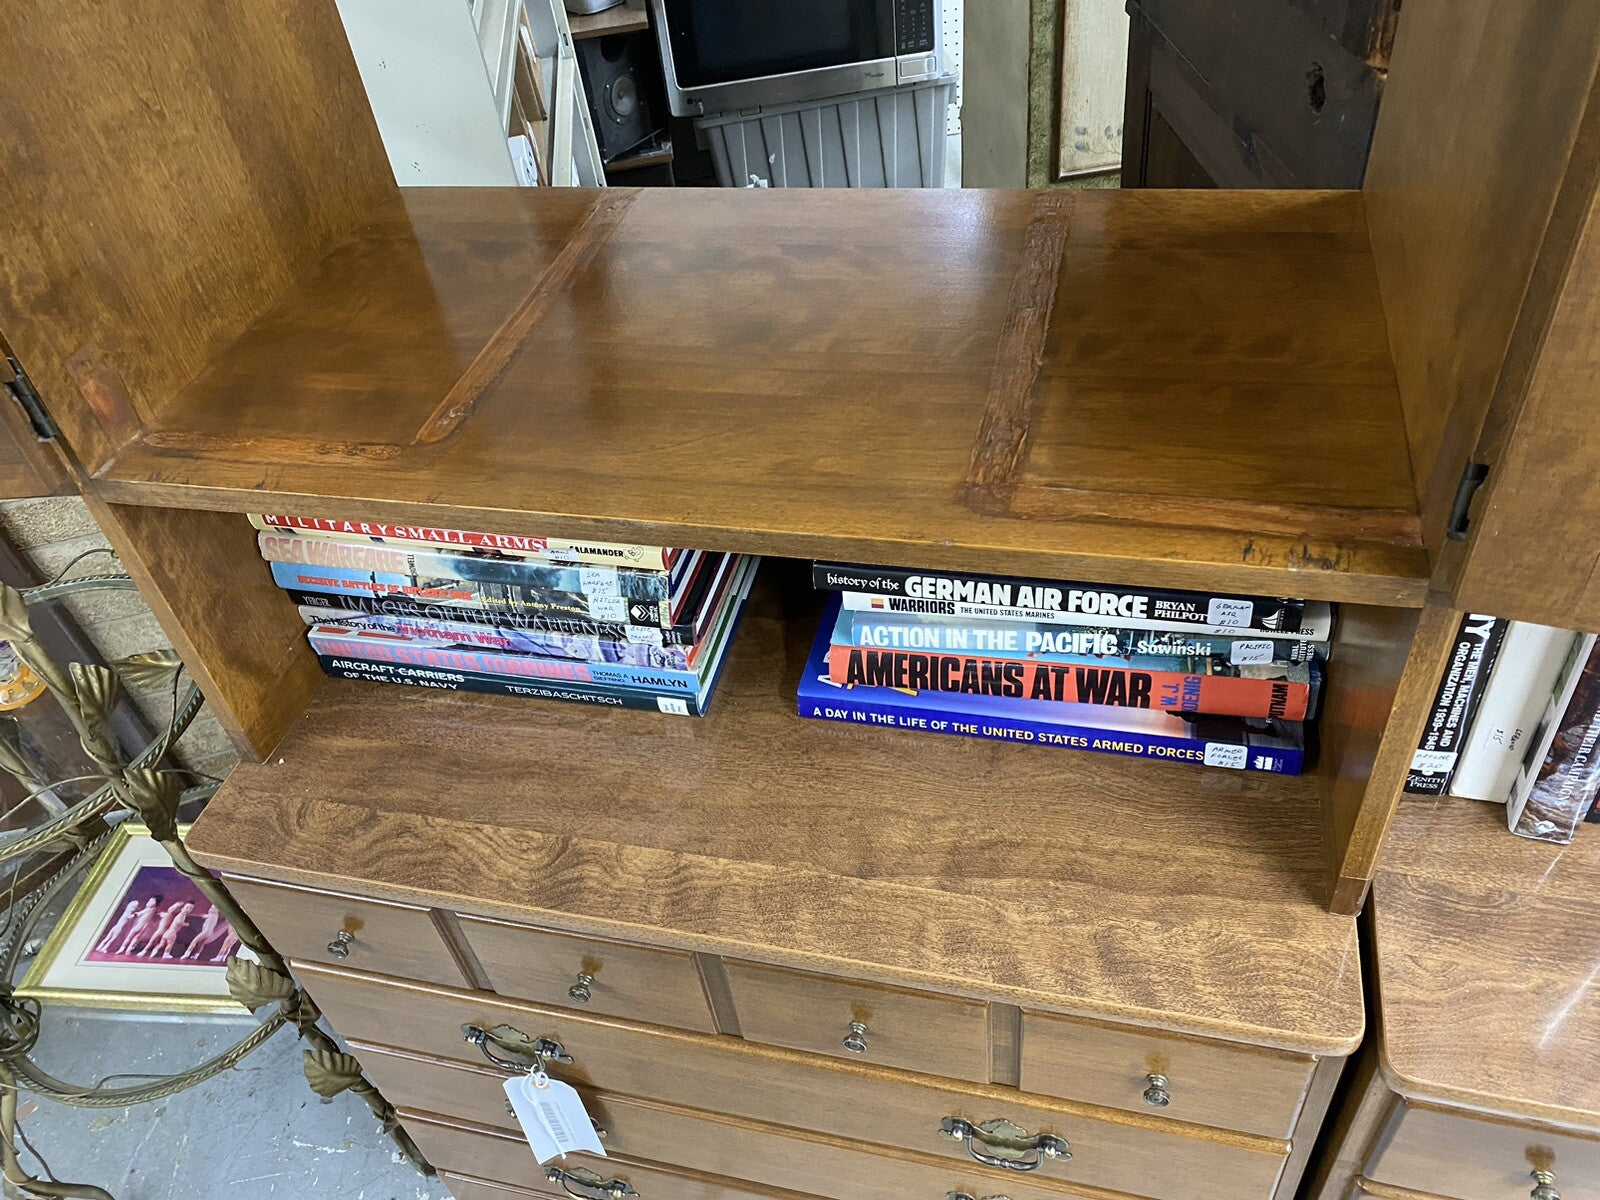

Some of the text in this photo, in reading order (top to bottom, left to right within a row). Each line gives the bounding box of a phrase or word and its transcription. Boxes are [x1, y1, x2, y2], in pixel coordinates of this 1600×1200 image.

[394, 525, 472, 545] SMALL
[479, 534, 548, 552] ARMS
[265, 537, 401, 574] SEA WARFARE
[338, 596, 422, 616] IMAGES
[481, 597, 506, 605] Edited
[521, 602, 549, 611] Antony
[551, 604, 580, 612] Preston
[827, 573, 1149, 618] history of the GERMAN AIR FORCE
[889, 598, 956, 615] WARRIORS
[960, 606, 978, 614] THE
[981, 608, 998, 616] UNITED
[1025, 612, 1055, 620] MARINES
[1155, 601, 1196, 612] BRYAN
[310, 615, 332, 627] The
[332, 619, 367, 631] History
[380, 625, 396, 633] the
[396, 623, 472, 642] Vietnam
[473, 631, 511, 648] War
[860, 625, 1118, 656] ACTION IN THE PACIFIC
[1137, 641, 1211, 656] Sowinski
[1470, 643, 1485, 661] THE
[332, 659, 465, 683] AIRCRAFT CARRIERS
[847, 649, 1024, 698] AMERICANS
[1030, 664, 1069, 702] AT
[1076, 668, 1152, 709] WAR
[363, 673, 390, 682] THE
[394, 677, 417, 687] U.S.
[419, 681, 458, 691] NAVY
[632, 676, 688, 688] HAMLYN
[505, 686, 623, 706] TERZIBASCHITSCH
[1424, 641, 1471, 751] ORGANIZATION 1939-1945
[1446, 684, 1472, 728] MACHINES
[813, 707, 1204, 761] A DAY IN THE LIFE OF THE UNITED STATES ARMED FORCES
[1439, 729, 1454, 747] AND
[1407, 774, 1445, 783] ZENITH
[1409, 780, 1438, 789] PRESS
